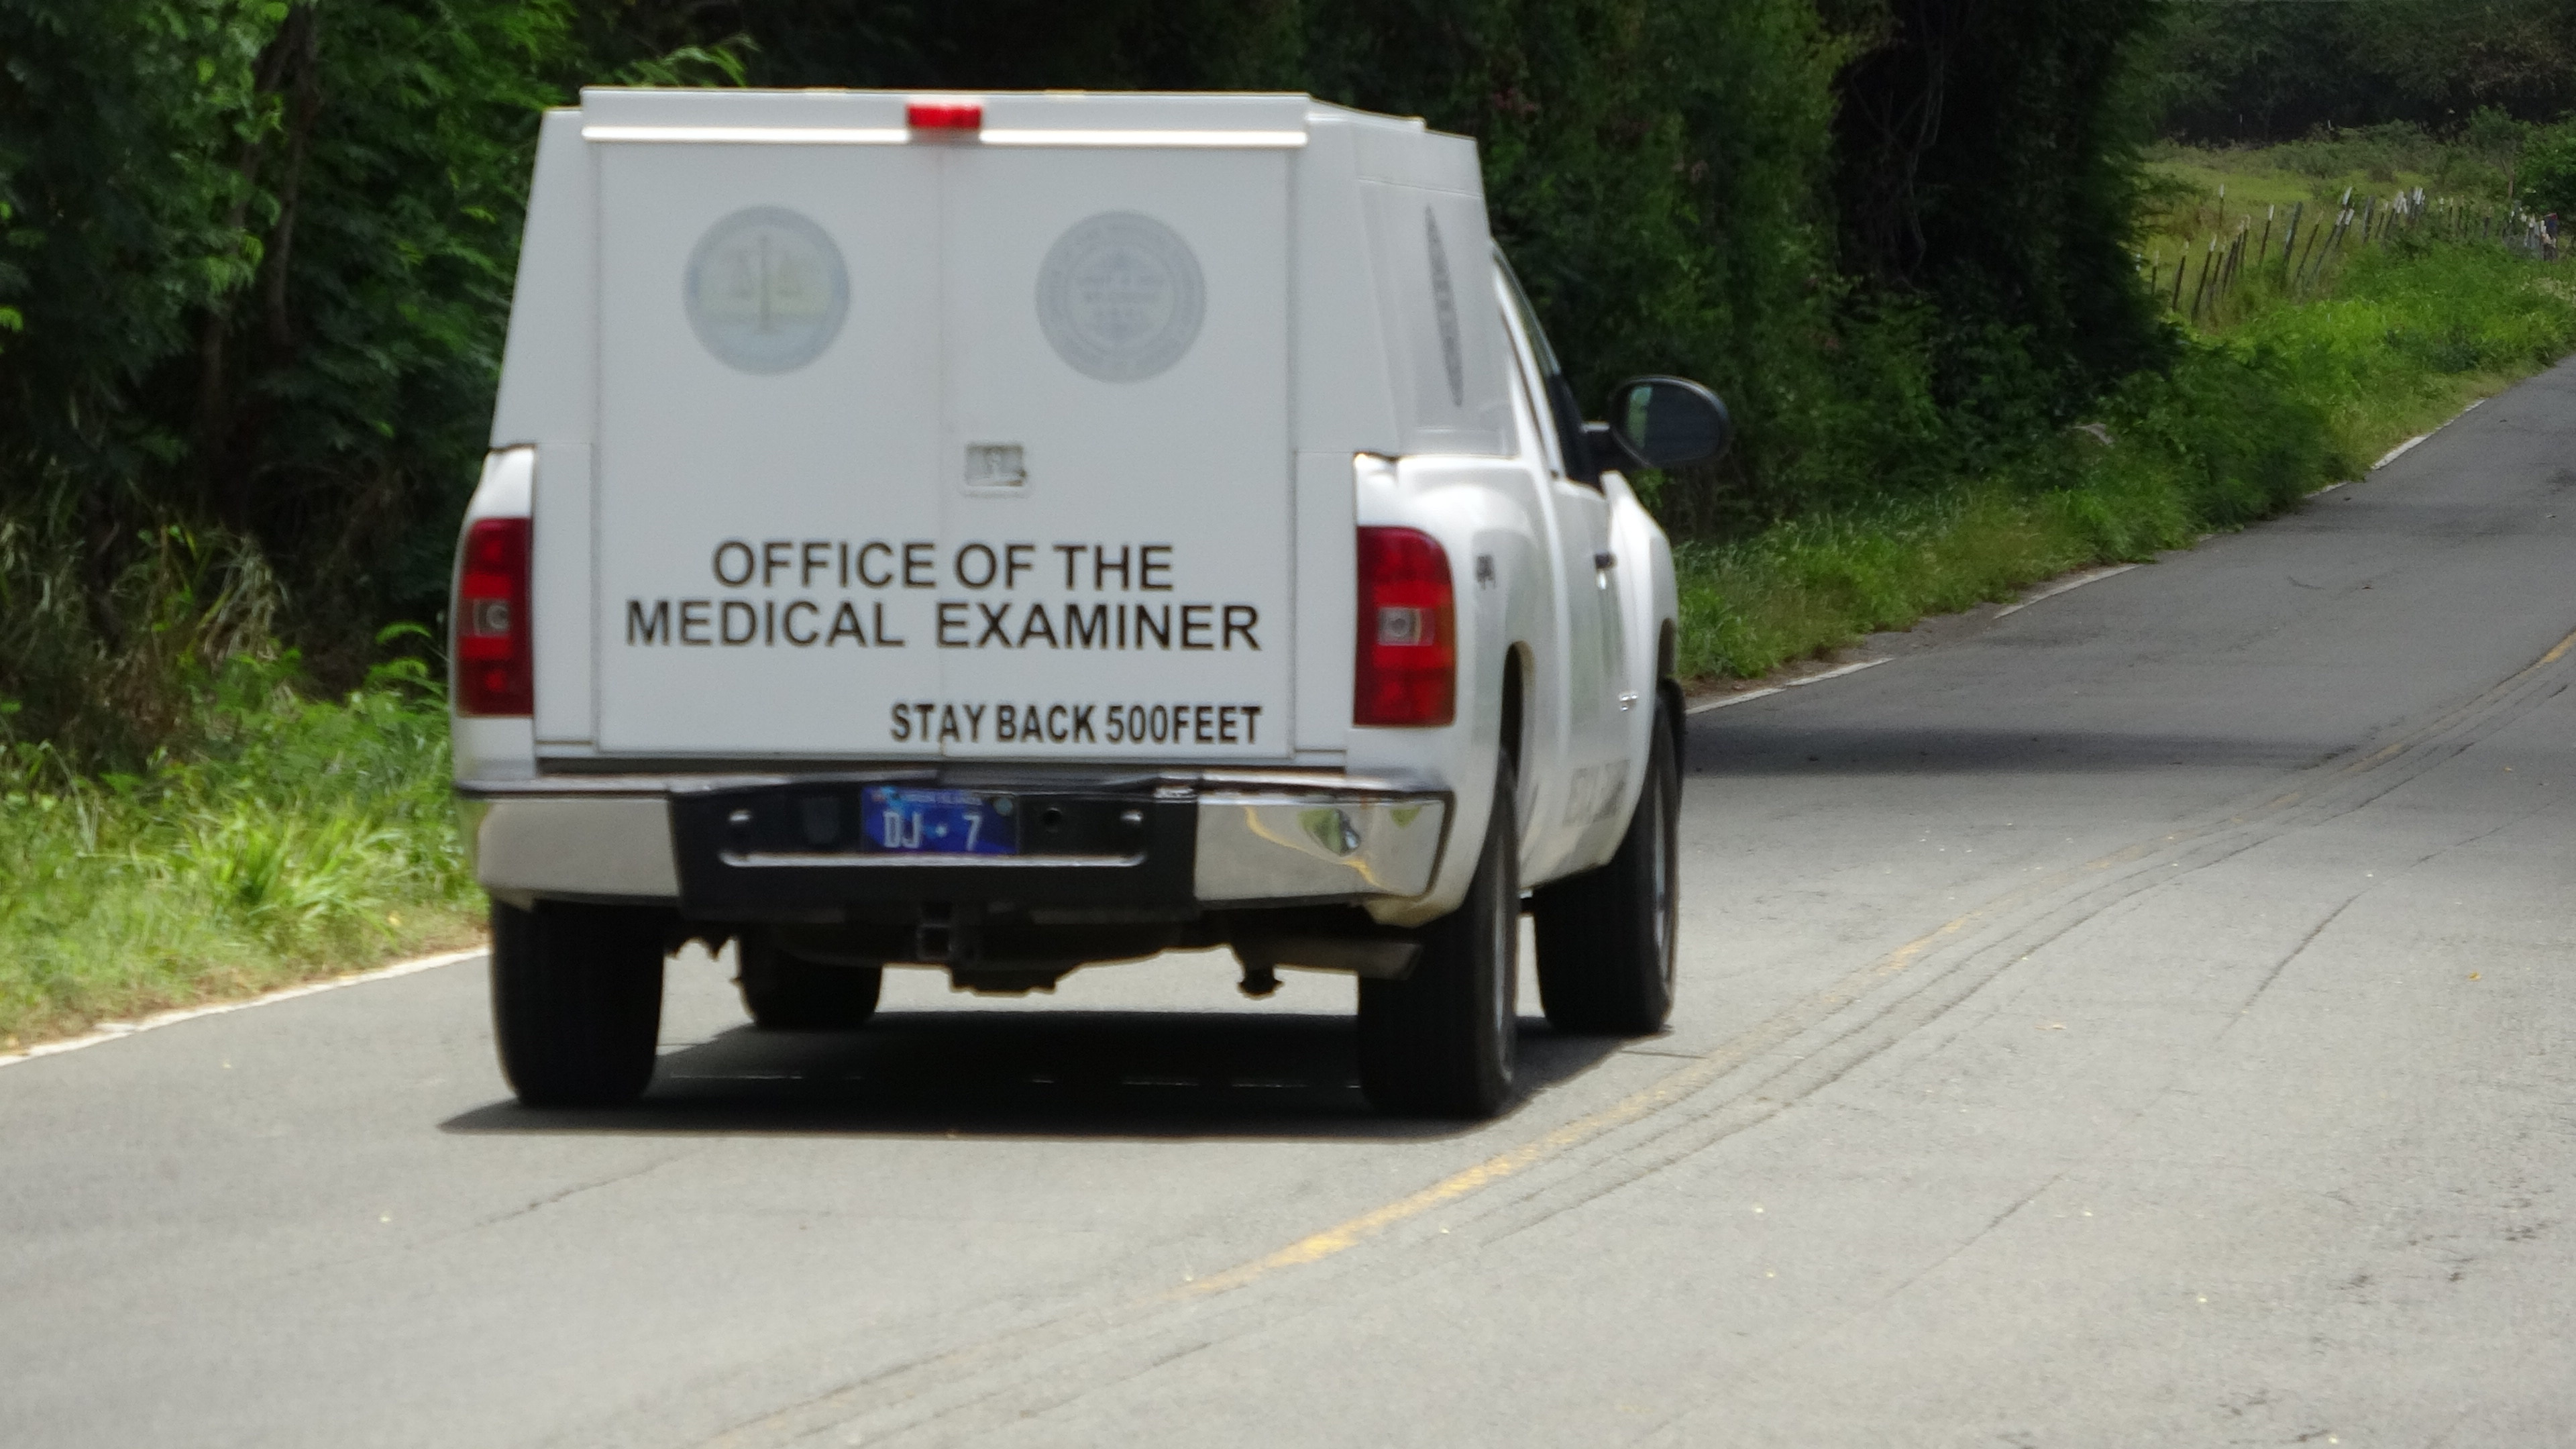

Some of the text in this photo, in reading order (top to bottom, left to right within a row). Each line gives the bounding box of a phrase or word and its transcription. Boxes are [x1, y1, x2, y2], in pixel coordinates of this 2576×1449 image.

[712, 539, 1174, 592] OFFICE OF THE
[626, 598, 1261, 651] MEDICAL EXAMINER
[890, 702, 987, 745] STAY
[995, 703, 1097, 745] BACK
